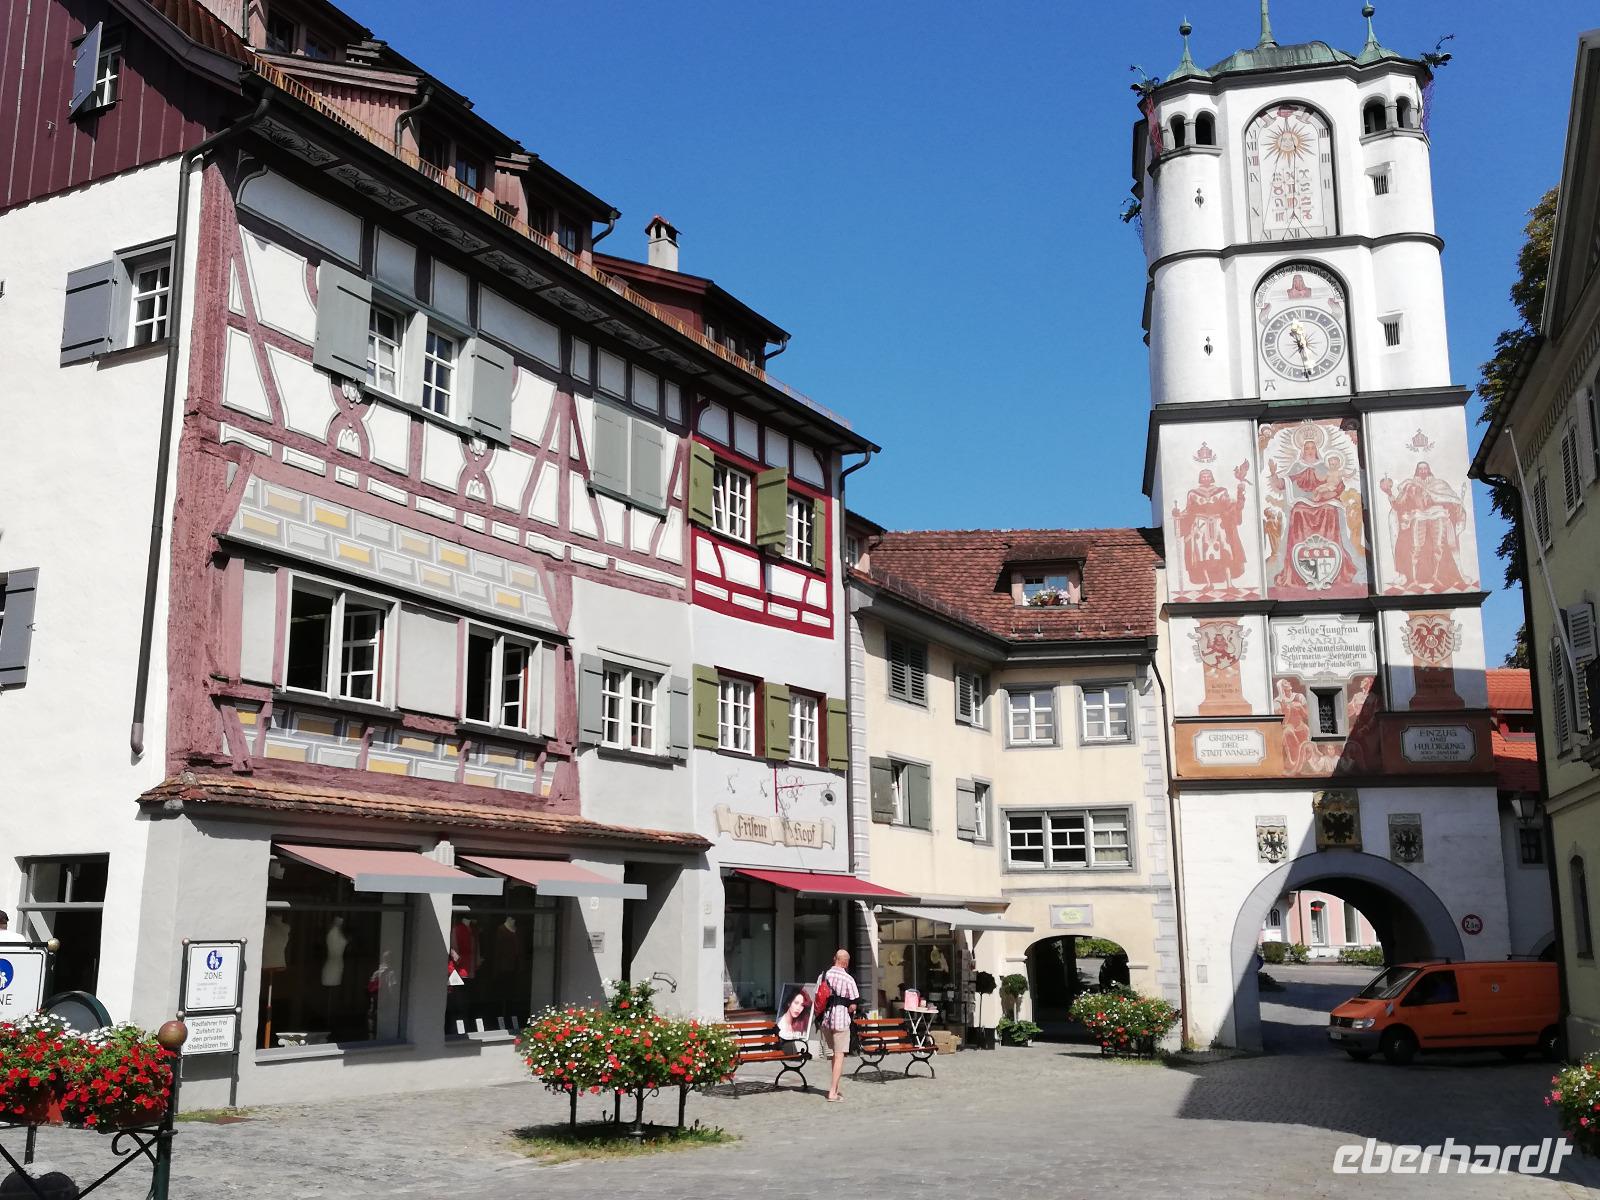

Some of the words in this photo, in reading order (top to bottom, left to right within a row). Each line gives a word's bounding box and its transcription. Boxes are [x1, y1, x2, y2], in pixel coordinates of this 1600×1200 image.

[1321, 153, 1330, 163] III
[1287, 626, 1320, 636] Heilige
[1319, 624, 1359, 637] Jungfrau
[1301, 637, 1347, 645] MARIA
[204, 971, 223, 980] ZONE
